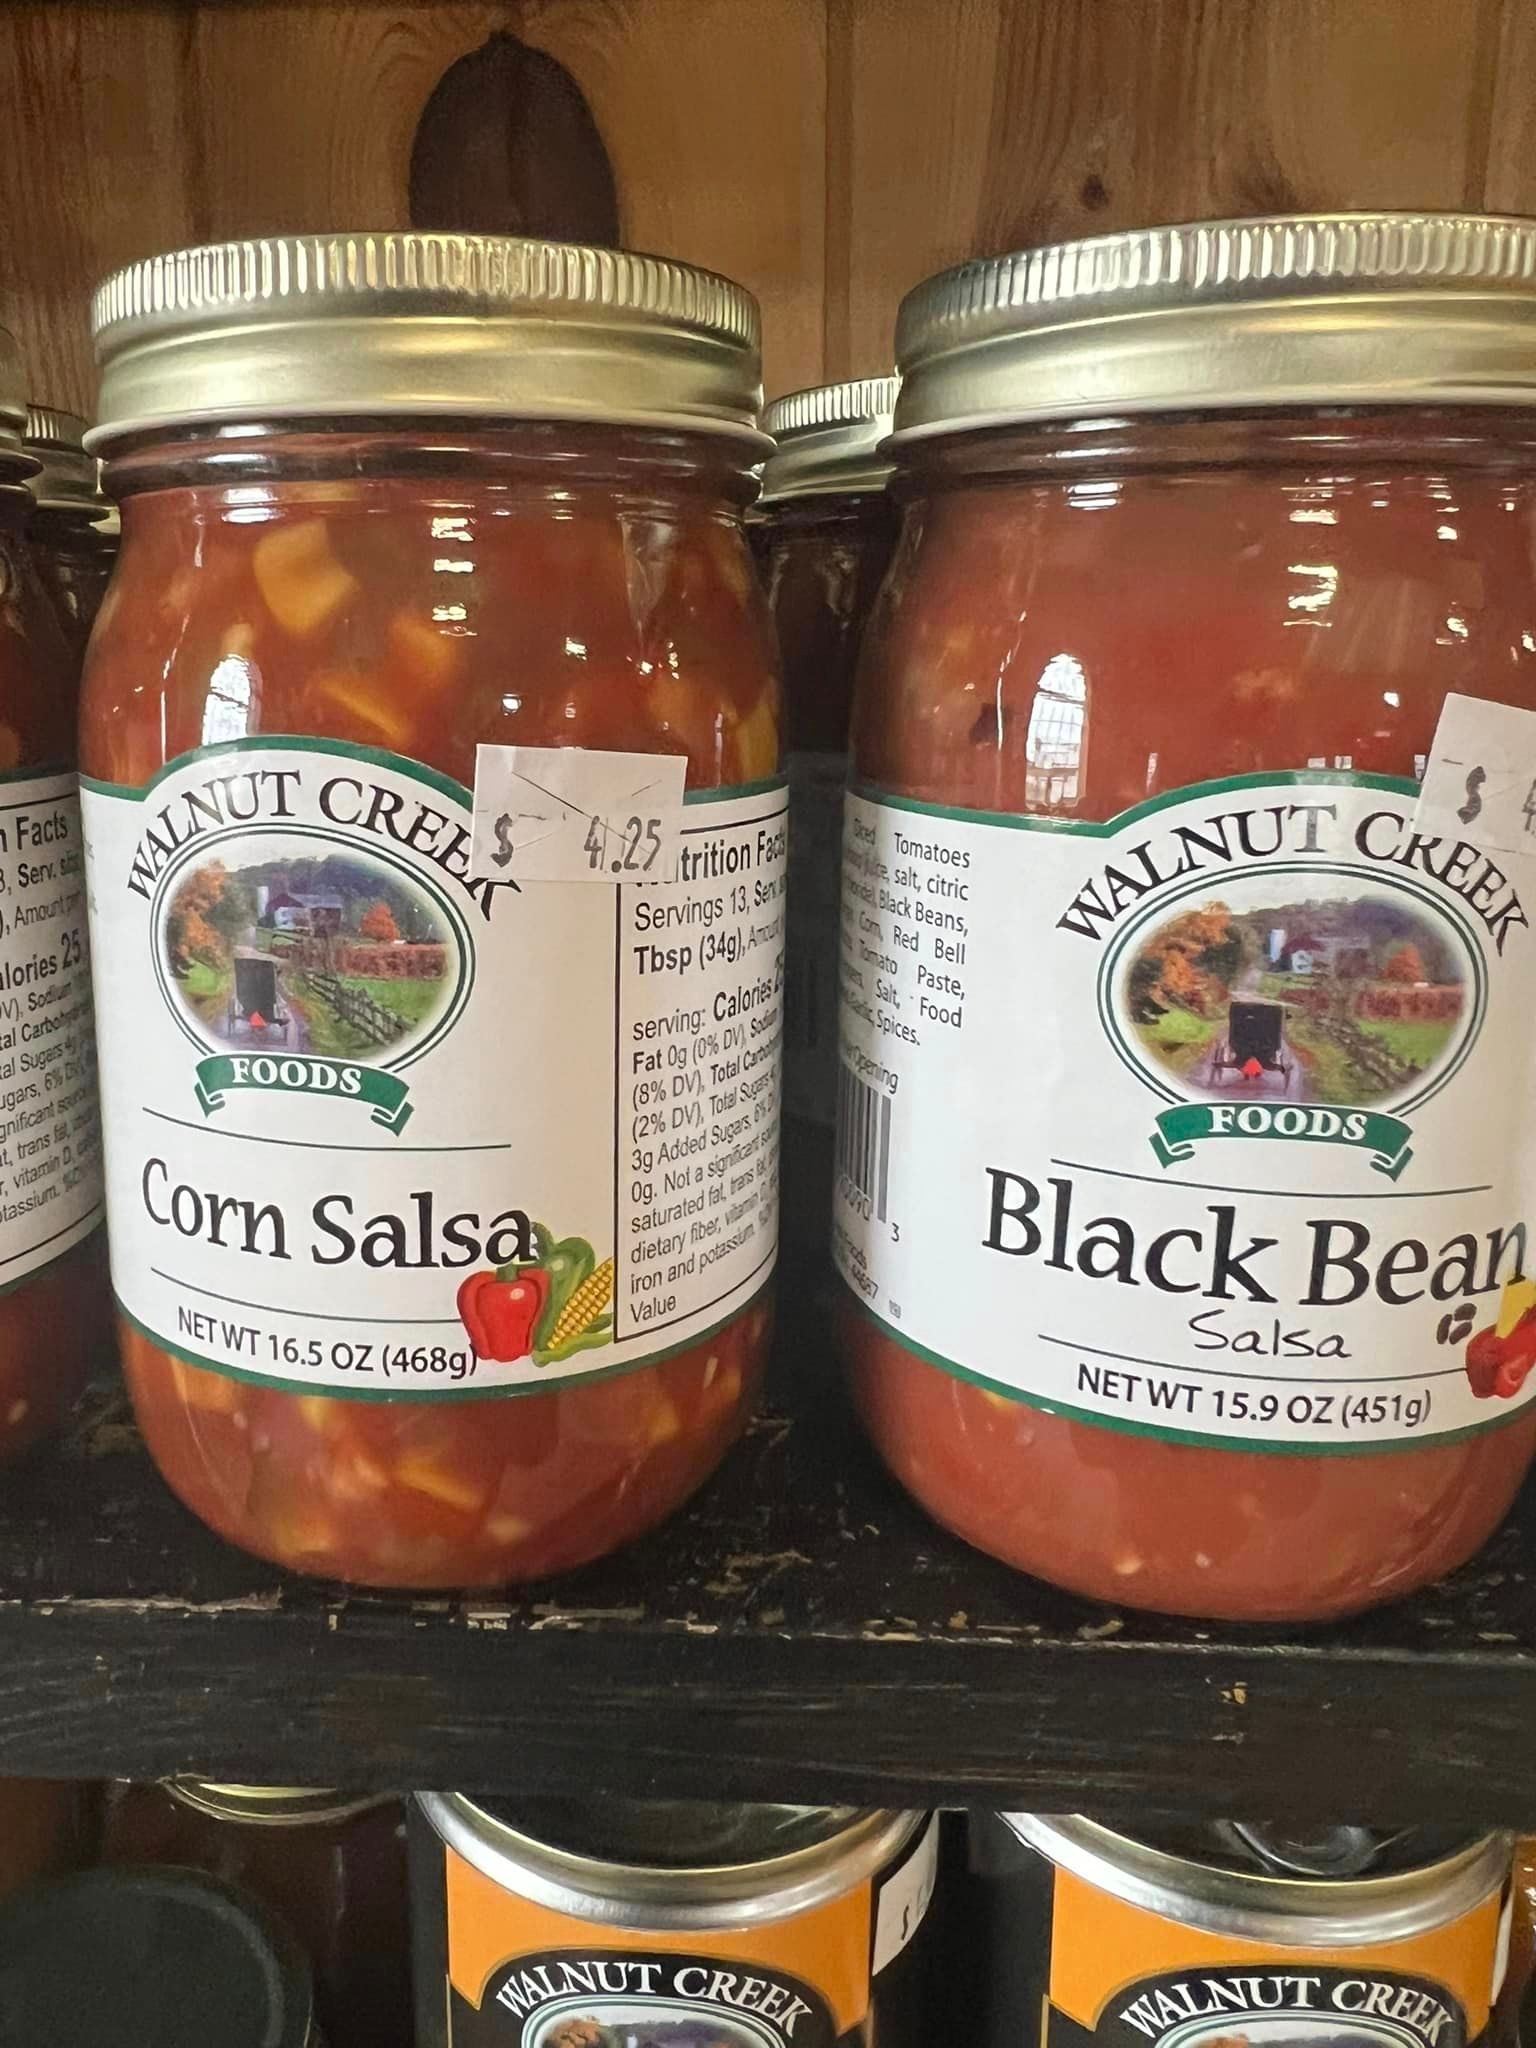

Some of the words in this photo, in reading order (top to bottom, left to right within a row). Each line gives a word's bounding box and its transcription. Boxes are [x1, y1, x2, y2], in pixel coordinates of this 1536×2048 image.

[16, 810, 69, 851] Facts
[127, 770, 302, 902] WALNUT
[583, 815, 663, 873] 4.25
[894, 832, 971, 869] Tomatoes
[18, 860, 57, 889] Serv.
[635, 840, 751, 887] trition
[894, 866, 922, 893] salt,
[927, 874, 970, 901] citric
[1056, 804, 1337, 942] WALNUT
[1355, 811, 1530, 957] CREEK
[634, 897, 724, 932] Servings
[730, 886, 750, 915] 13,
[880, 889, 912, 919] Black
[915, 901, 969, 938] Beans,
[0, 952, 58, 992] alories
[61, 928, 82, 970] 25
[633, 944, 693, 976] Tbsp
[700, 926, 747, 970] (34g),
[893, 925, 919, 952] Red
[935, 938, 966, 964] Bell
[876, 978, 901, 1010] Salt,
[919, 996, 963, 1029] Food
[917, 965, 966, 1001] Paste,
[632, 1007, 707, 1042] serving:
[713, 977, 772, 1021] Calories
[876, 1008, 921, 1046] Spices.
[20, 1042, 63, 1073] Sugars
[230, 1057, 362, 1095] FOODS
[633, 1049, 662, 1075] Fat
[667, 1044, 687, 1068] 0g
[692, 1034, 720, 1067] (0%
[0, 1081, 42, 1113] ugars,
[633, 1079, 667, 1112] (8%
[672, 1069, 705, 1099] DV),
[710, 1053, 740, 1087] Total
[0, 1100, 55, 1146] gnificant
[632, 1113, 667, 1144] (2%
[671, 1100, 705, 1128] DV),
[709, 1089, 737, 1118] Total
[1207, 1106, 1369, 1141] FOODS
[17, 1133, 51, 1161] trans
[631, 1148, 654, 1174] 3g
[658, 1131, 707, 1166] Added
[13, 1156, 60, 1189] vitamin
[631, 1180, 658, 1206] 0g.
[664, 1163, 691, 1191] Not
[694, 1166, 704, 1184] a
[142, 1157, 292, 1260] Corn
[311, 1191, 539, 1268] Salsa
[631, 1193, 705, 1234] saturated
[890, 1222, 900, 1242] 3
[631, 1229, 686, 1265] dietary
[690, 1214, 722, 1247] fiber,
[982, 1166, 1278, 1304] Black
[1299, 1218, 1527, 1307] Bean
[630, 1269, 663, 1295] iron
[667, 1252, 695, 1281] and
[630, 1293, 677, 1324] Value
[178, 1306, 219, 1344] NET
[220, 1322, 261, 1356] WT
[268, 1333, 323, 1366] 16.5
[330, 1342, 374, 1371] OZ
[381, 1344, 478, 1379] (468g)
[1188, 1309, 1353, 1360] Salsa
[1077, 1362, 1141, 1397] NET
[1145, 1378, 1203, 1413] WT
[1212, 1390, 1278, 1422] 15.9
[1287, 1396, 1335, 1425] OZ
[1340, 1389, 1432, 1429] (451g)
[496, 1960, 662, 2020] WALNUT
[672, 1966, 813, 2038] CREEK
[1120, 1976, 1321, 2040] WALNUT
[1332, 1980, 1455, 2047] CREEK
